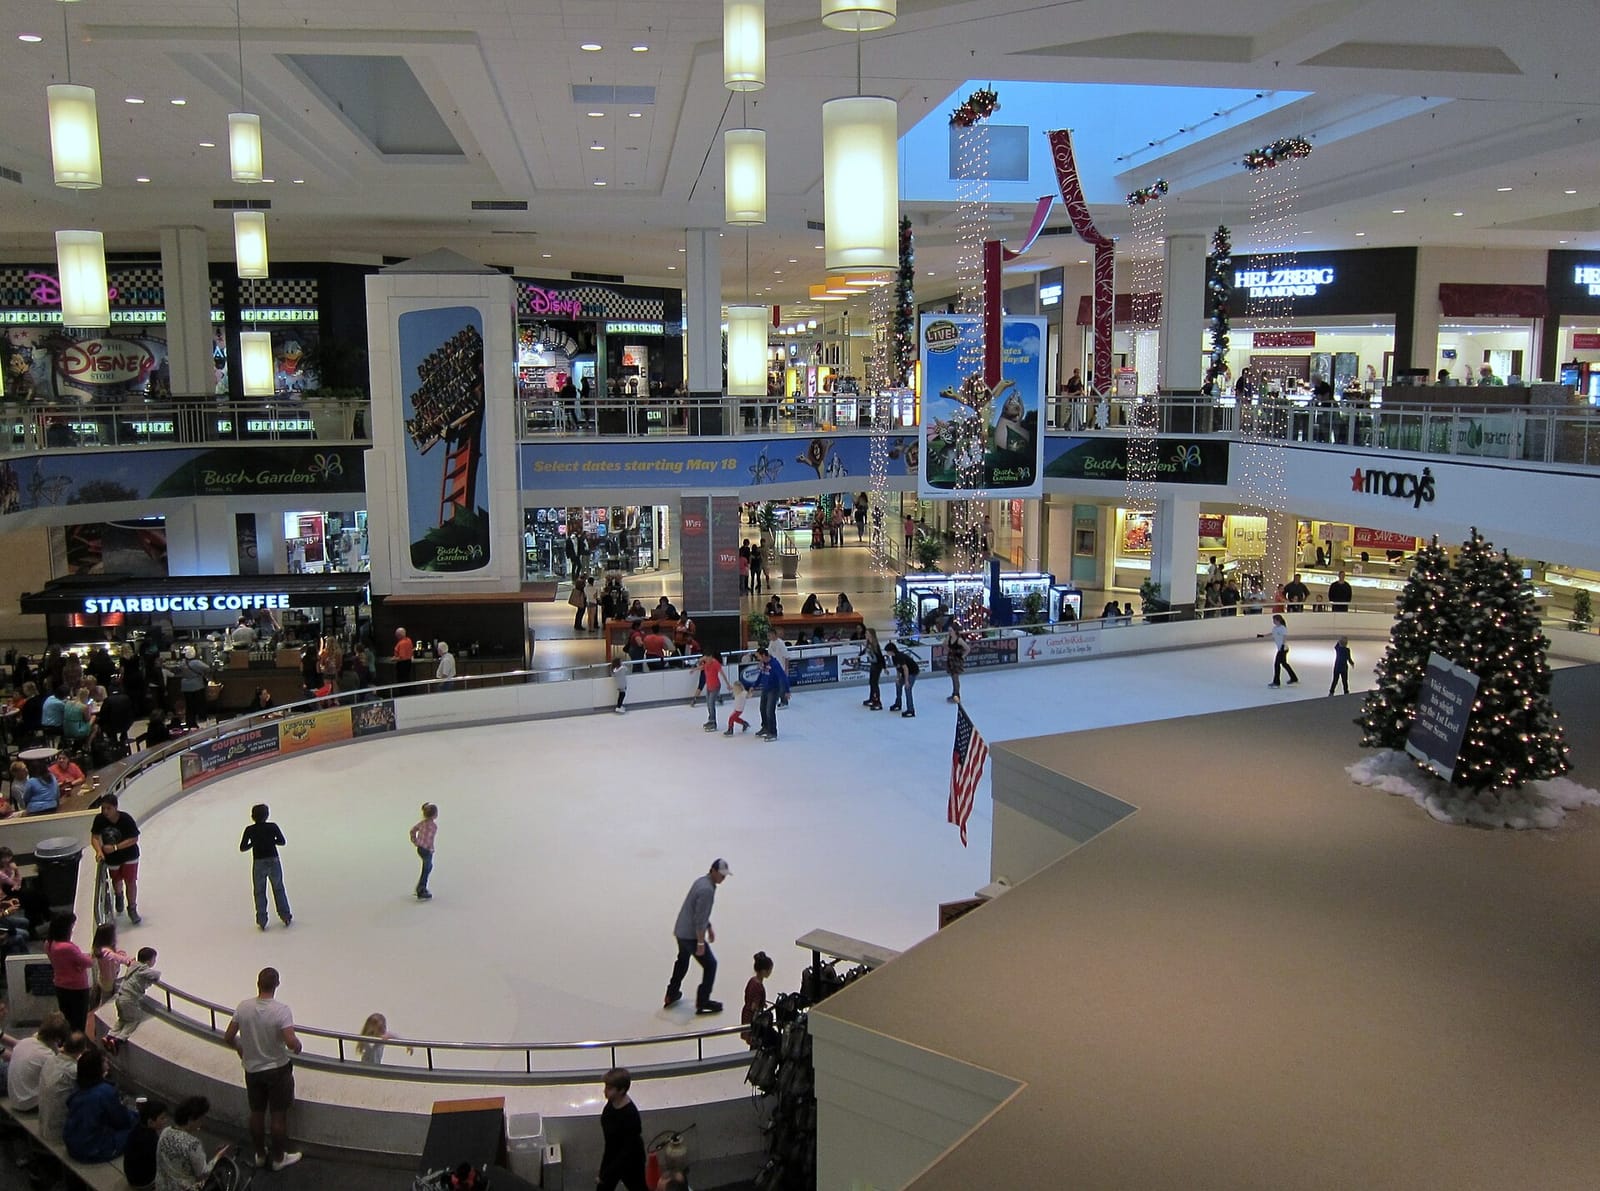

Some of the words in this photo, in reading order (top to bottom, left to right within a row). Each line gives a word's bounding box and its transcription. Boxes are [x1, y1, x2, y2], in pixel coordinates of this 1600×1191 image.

[1234, 268, 1334, 288] HELZBERG
[1249, 285, 1317, 298] DIAMONDS
[926, 327, 956, 341] LIVE!
[533, 459, 579, 472] Select
[581, 459, 621, 472] dates
[623, 458, 683, 474] starting
[685, 458, 719, 473] May
[720, 458, 737, 470] 18
[993, 467, 1015, 476] Busch
[1082, 456, 1126, 471] Busch
[1126, 458, 1178, 473] Gardens
[201, 469, 256, 485] Busch
[256, 468, 317, 485] Gardens
[1365, 467, 1436, 508] macy's
[1374, 531, 1393, 542] SAVE
[435, 546, 463, 555] Busch
[436, 554, 469, 562] Gardens
[85, 596, 210, 614] STARBUCKS
[212, 594, 290, 610] COFFEE
[1430, 678, 1442, 692] Visit
[1441, 686, 1457, 701] Santa
[1430, 693, 1439, 706] his
[1439, 700, 1455, 716] sleigh
[1422, 719, 1434, 731] near
[1427, 705, 1436, 719] the
[1435, 711, 1445, 724] 1st
[1443, 717, 1460, 733] Level
